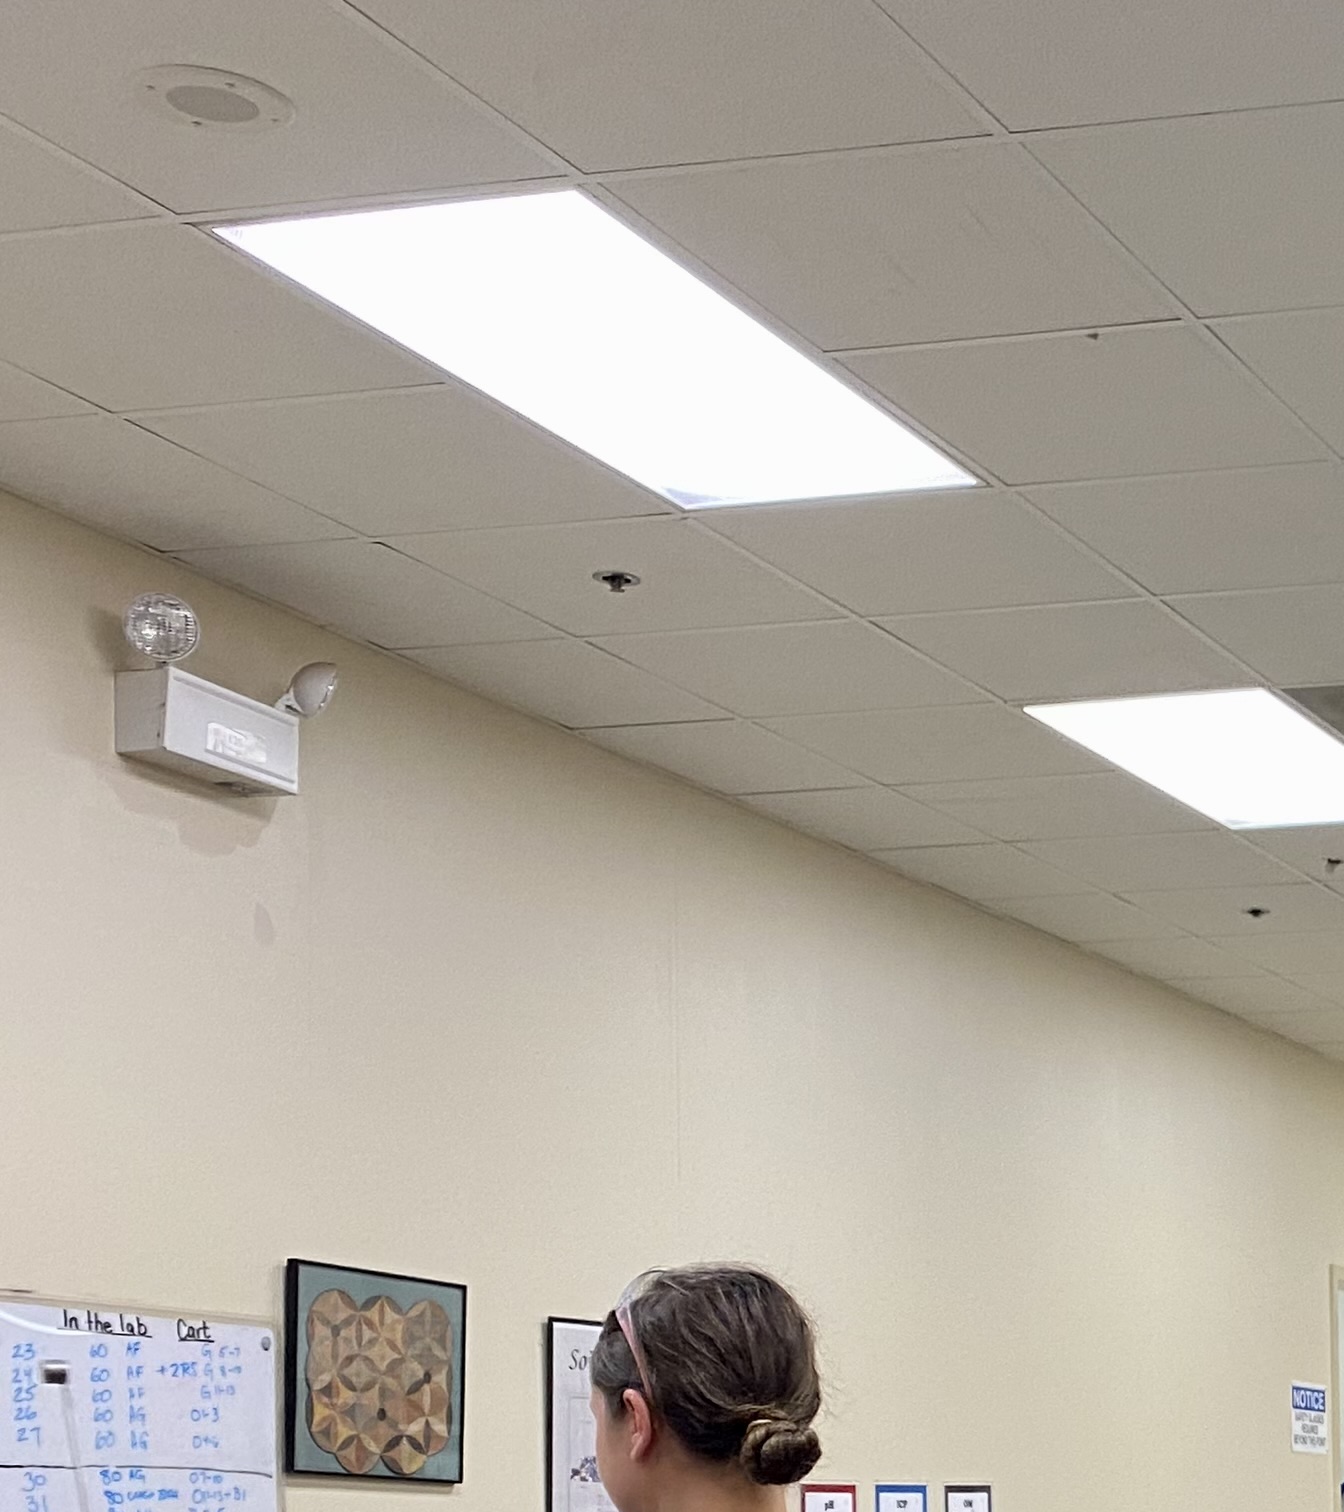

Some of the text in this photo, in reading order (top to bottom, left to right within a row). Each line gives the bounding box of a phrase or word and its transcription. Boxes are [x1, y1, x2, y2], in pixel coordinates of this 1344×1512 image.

[63, 1309, 148, 1336] In the lab
[177, 1318, 212, 1340] Cart
[12, 1343, 36, 1360] 23
[90, 1367, 111, 1382] 60
[13, 1383, 38, 1402] 25
[1293, 1389, 1324, 1410] NOTICE
[17, 1427, 41, 1447] 27
[22, 1471, 47, 1492] 30
